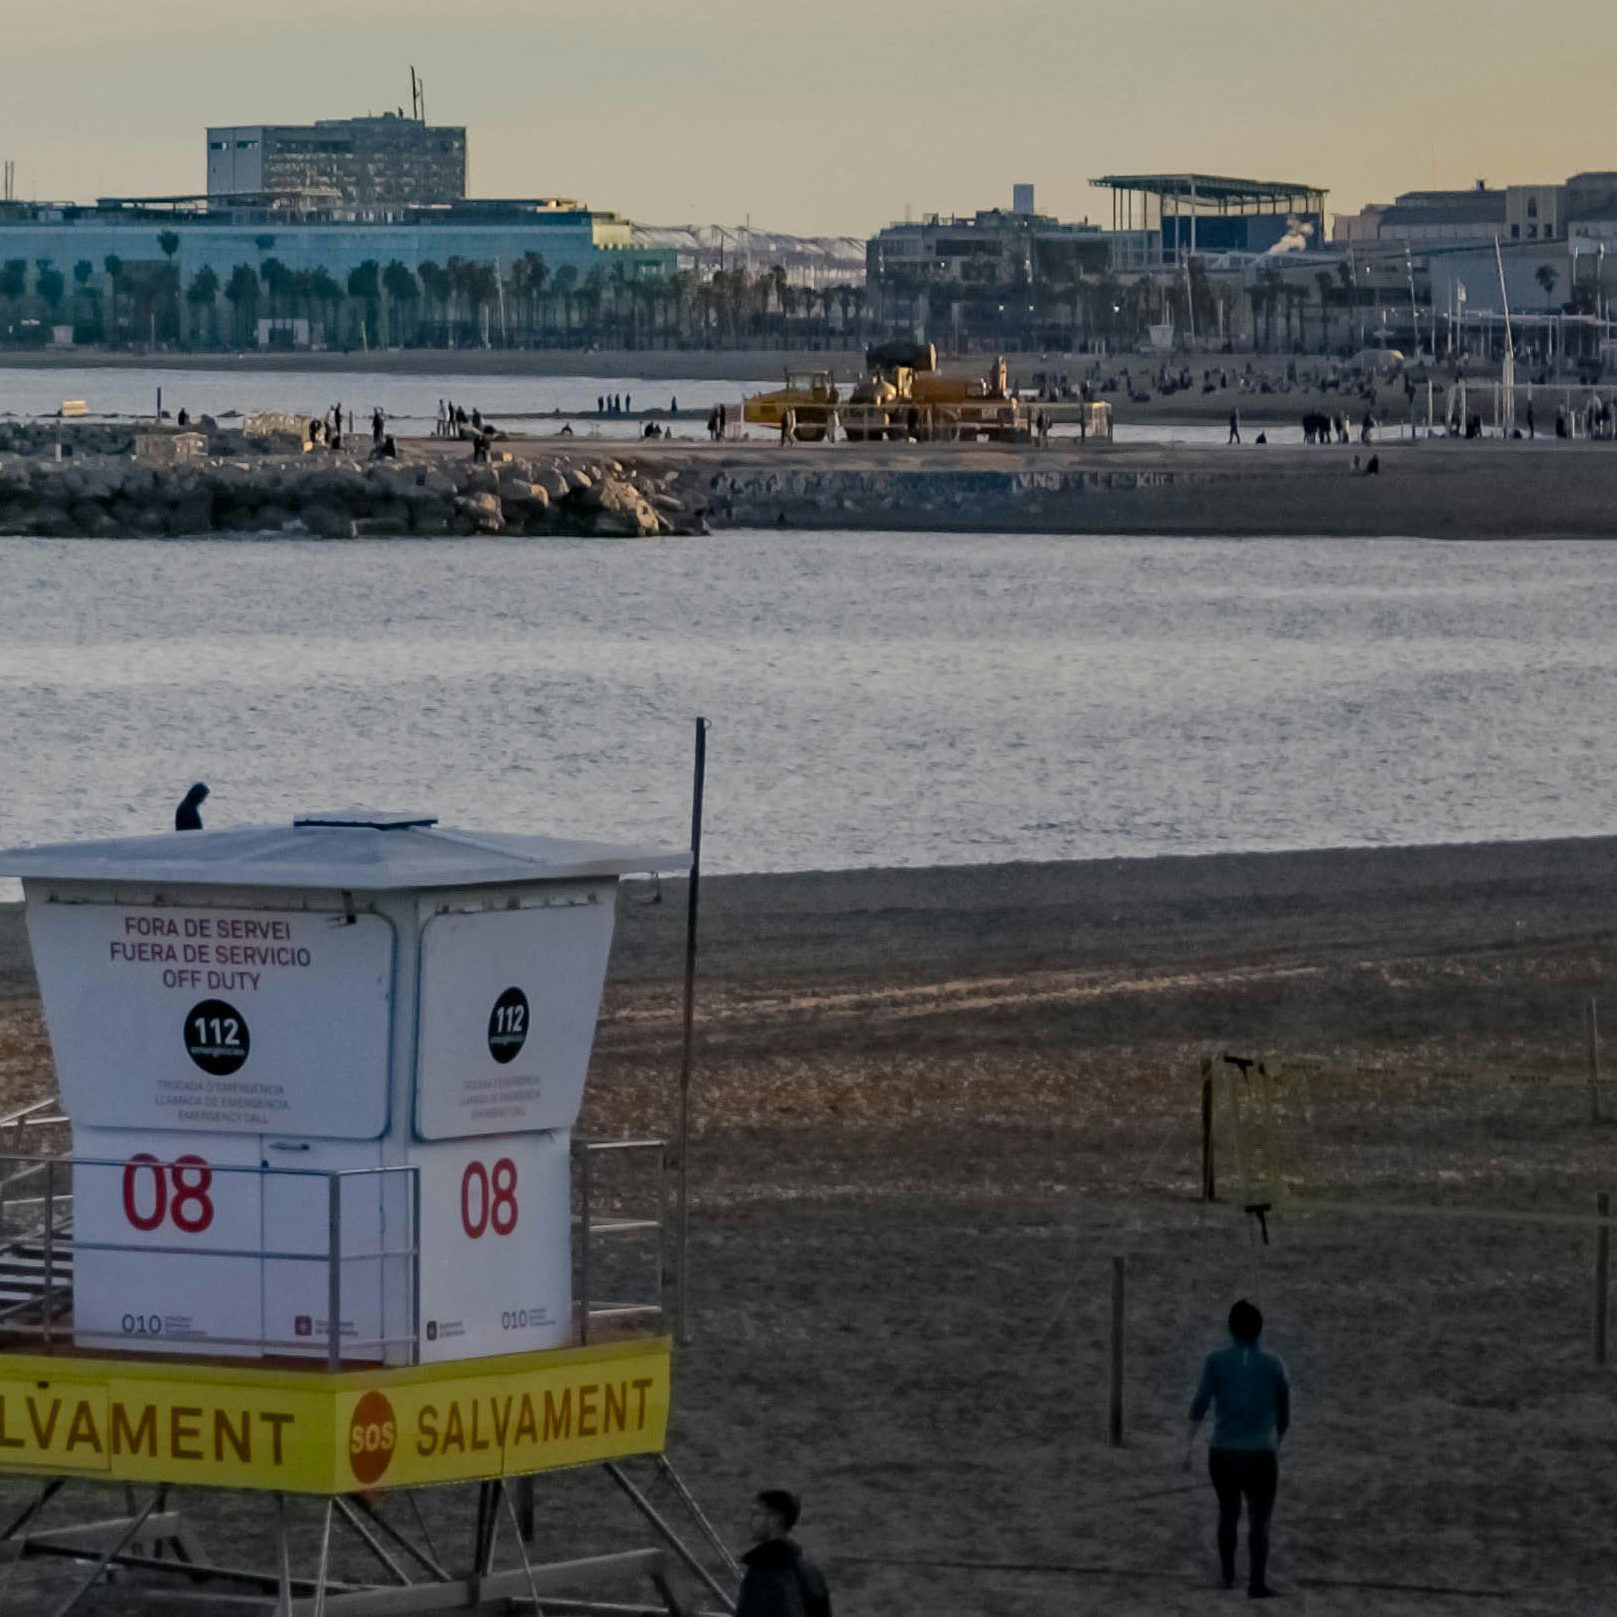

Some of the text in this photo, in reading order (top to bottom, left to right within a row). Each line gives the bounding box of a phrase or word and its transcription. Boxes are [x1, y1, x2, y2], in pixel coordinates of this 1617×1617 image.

[125, 917, 291, 940] FORA DE SERVEI
[109, 941, 311, 967] FUERA DE SERVICIO
[162, 969, 261, 991] OFF DUTY
[194, 1017, 240, 1045] 112
[497, 1004, 525, 1033] 112
[122, 1152, 215, 1234] 08
[461, 1157, 519, 1239] 08
[121, 1313, 162, 1334] 010
[501, 1309, 528, 1330] 010
[350, 1377, 654, 1457] SOS SALVAMENT
